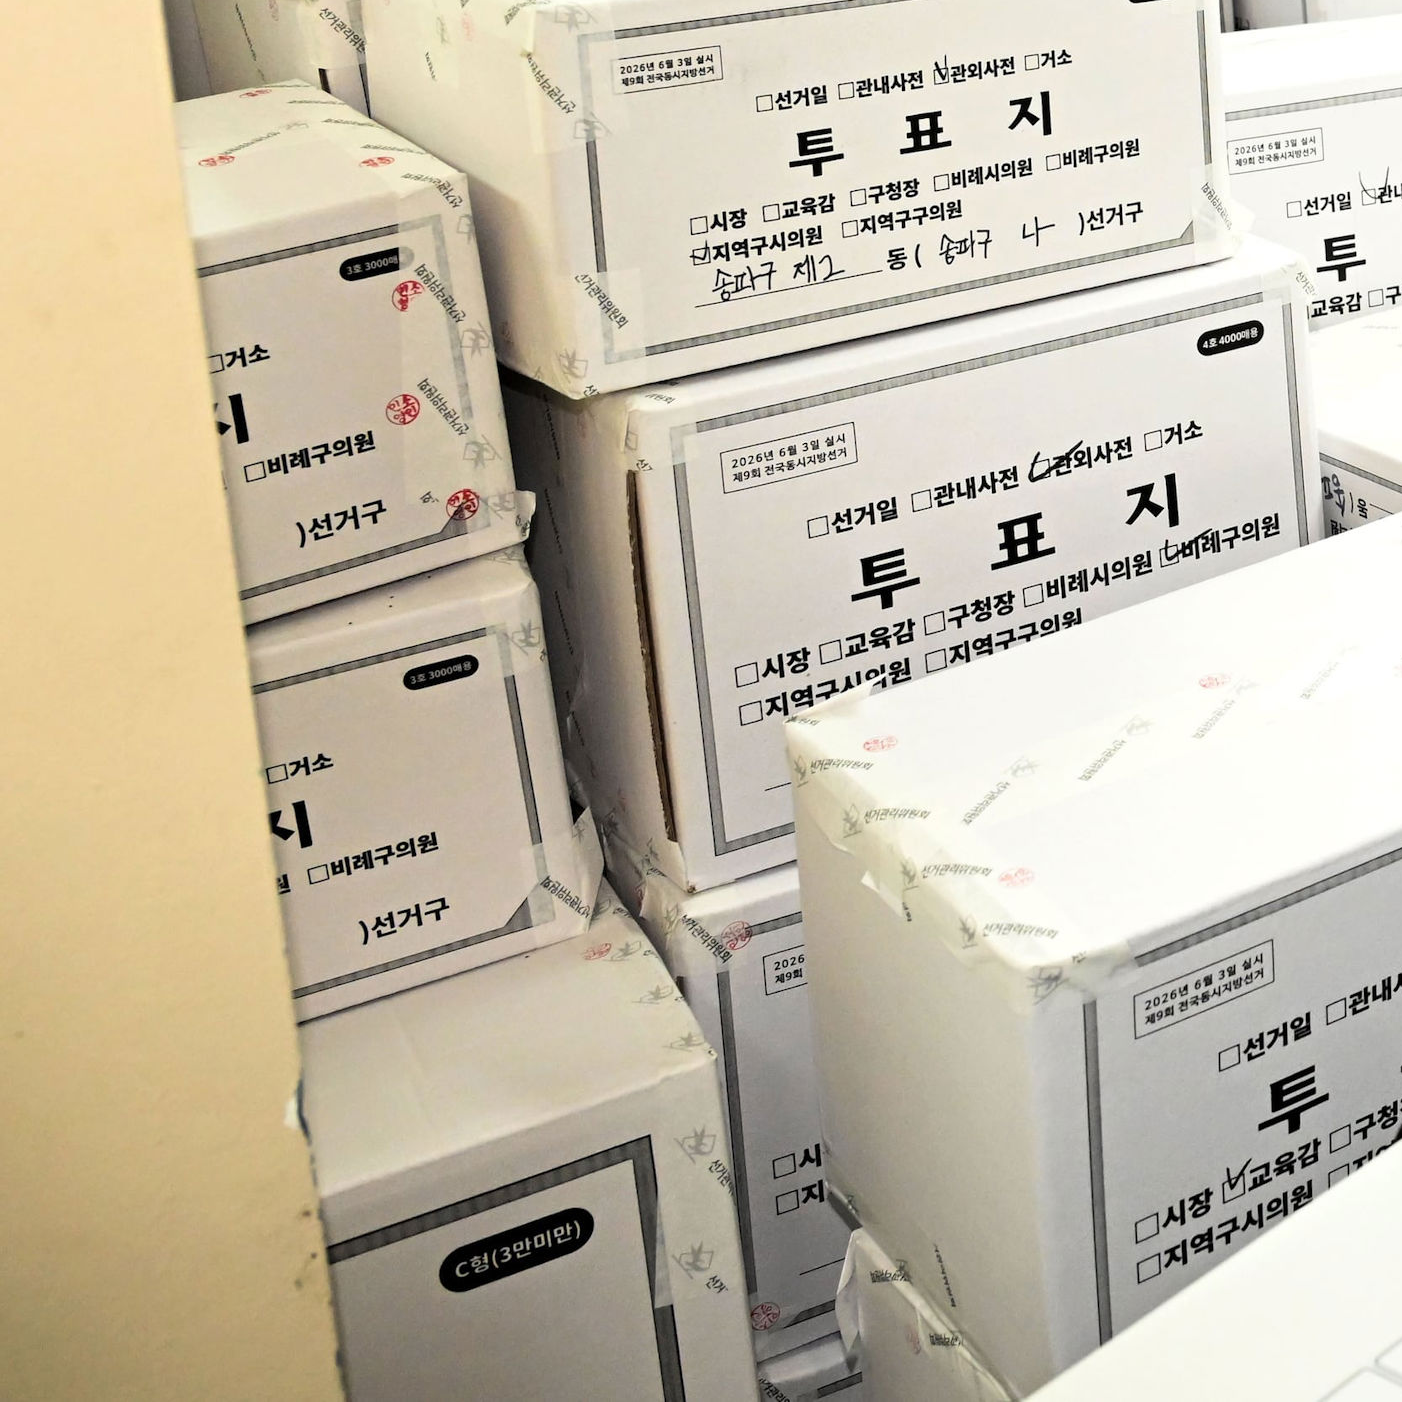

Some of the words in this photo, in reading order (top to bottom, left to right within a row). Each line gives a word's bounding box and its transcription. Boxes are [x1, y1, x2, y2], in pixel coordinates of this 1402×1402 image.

[620, 61, 655, 75] 2026년
[658, 58, 674, 69] 6월
[677, 56, 692, 67] 3일
[696, 53, 714, 65] 실시
[622, 73, 644, 87] 제9회
[646, 65, 715, 84] 전국동시지방선거
[775, 86, 827, 110] 선거일
[856, 70, 924, 98] 관내사전
[951, 56, 1015, 82] 관외사전
[1041, 49, 1072, 68] 거소
[1234, 143, 1265, 156] 2026년
[1268, 140, 1282, 152] 6월
[1285, 138, 1298, 149] 3일
[1300, 135, 1317, 147] 실시
[1234, 155, 1256, 168] 제9회
[1258, 147, 1317, 165] 전국동시지방선거
[710, 209, 747, 232] 시장
[782, 193, 835, 218] 교육감
[868, 179, 920, 204] 구청장
[951, 159, 1033, 188] 비례시의원
[1062, 139, 1140, 168] 비례구의원
[1304, 191, 1352, 216] 선거일
[712, 226, 823, 262] 지역구시의원
[860, 200, 962, 234] 지역구구의원
[1310, 293, 1362, 319] 교육감
[226, 344, 270, 368] 거소
[1202, 337, 1218, 350] 4호
[1219, 326, 1259, 346] 4000매용
[267, 430, 376, 477] 비례구의원
[731, 450, 774, 469] 2026년
[778, 445, 797, 458] 6월
[802, 439, 820, 452] 3일
[824, 433, 846, 448] 실시
[733, 467, 762, 483] 제9회
[764, 448, 848, 477] 전국동시지방선거
[831, 497, 898, 533] 선거일
[933, 466, 1019, 507] 관내사전
[1054, 436, 1132, 478] 관외사전
[1164, 420, 1203, 446] 거소
[762, 647, 811, 680] 시장
[845, 619, 915, 657] 교육감
[948, 591, 1015, 629] 구청장
[1045, 551, 1153, 600] 비례시의원
[1181, 513, 1280, 563] 비례구의원
[410, 671, 427, 685] 3호
[429, 661, 473, 681] 3000매용
[331, 831, 439, 877] 비례구의원
[1144, 984, 1190, 1011] 2026년
[1194, 974, 1214, 994] 6월
[1218, 964, 1237, 983] 3일
[1242, 953, 1264, 973] 실시
[1145, 1005, 1174, 1027] 제9회
[1178, 968, 1264, 1017] 전국동시지방선거
[1243, 1012, 1312, 1063] 선거일
[1162, 1189, 1213, 1231] 시장
[1248, 1138, 1321, 1193] 교육감
[455, 1220, 582, 1280] C형(3만미만)
